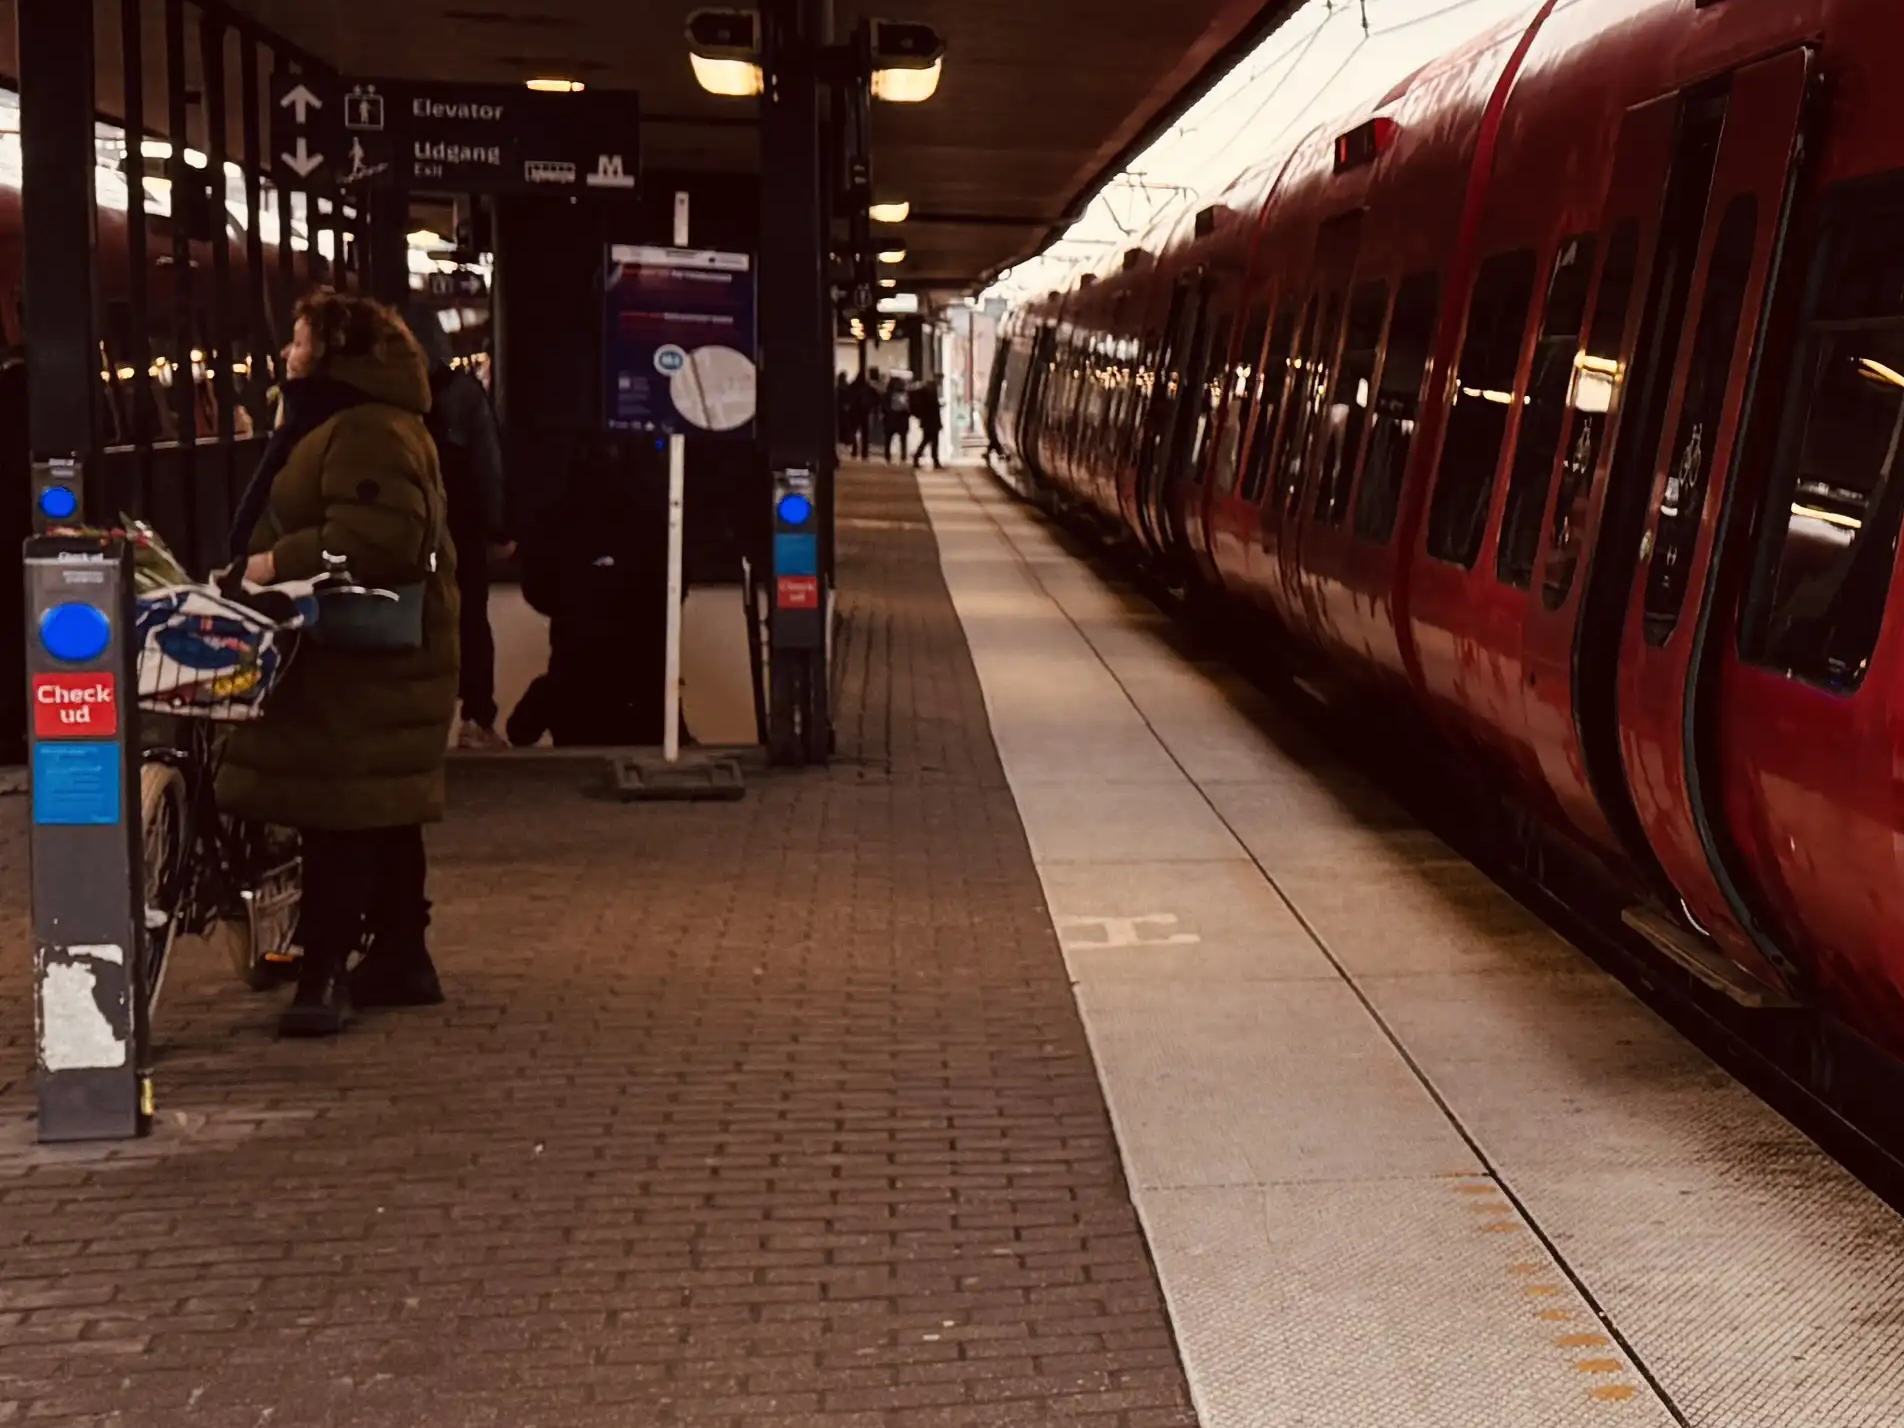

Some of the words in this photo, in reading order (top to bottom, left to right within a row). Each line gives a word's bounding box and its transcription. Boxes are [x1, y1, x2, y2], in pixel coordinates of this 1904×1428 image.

[412, 98, 503, 122] Elevator
[414, 140, 500, 166] Udgang
[599, 154, 624, 177] M
[37, 684, 111, 704] Check
[60, 705, 90, 723] ud
